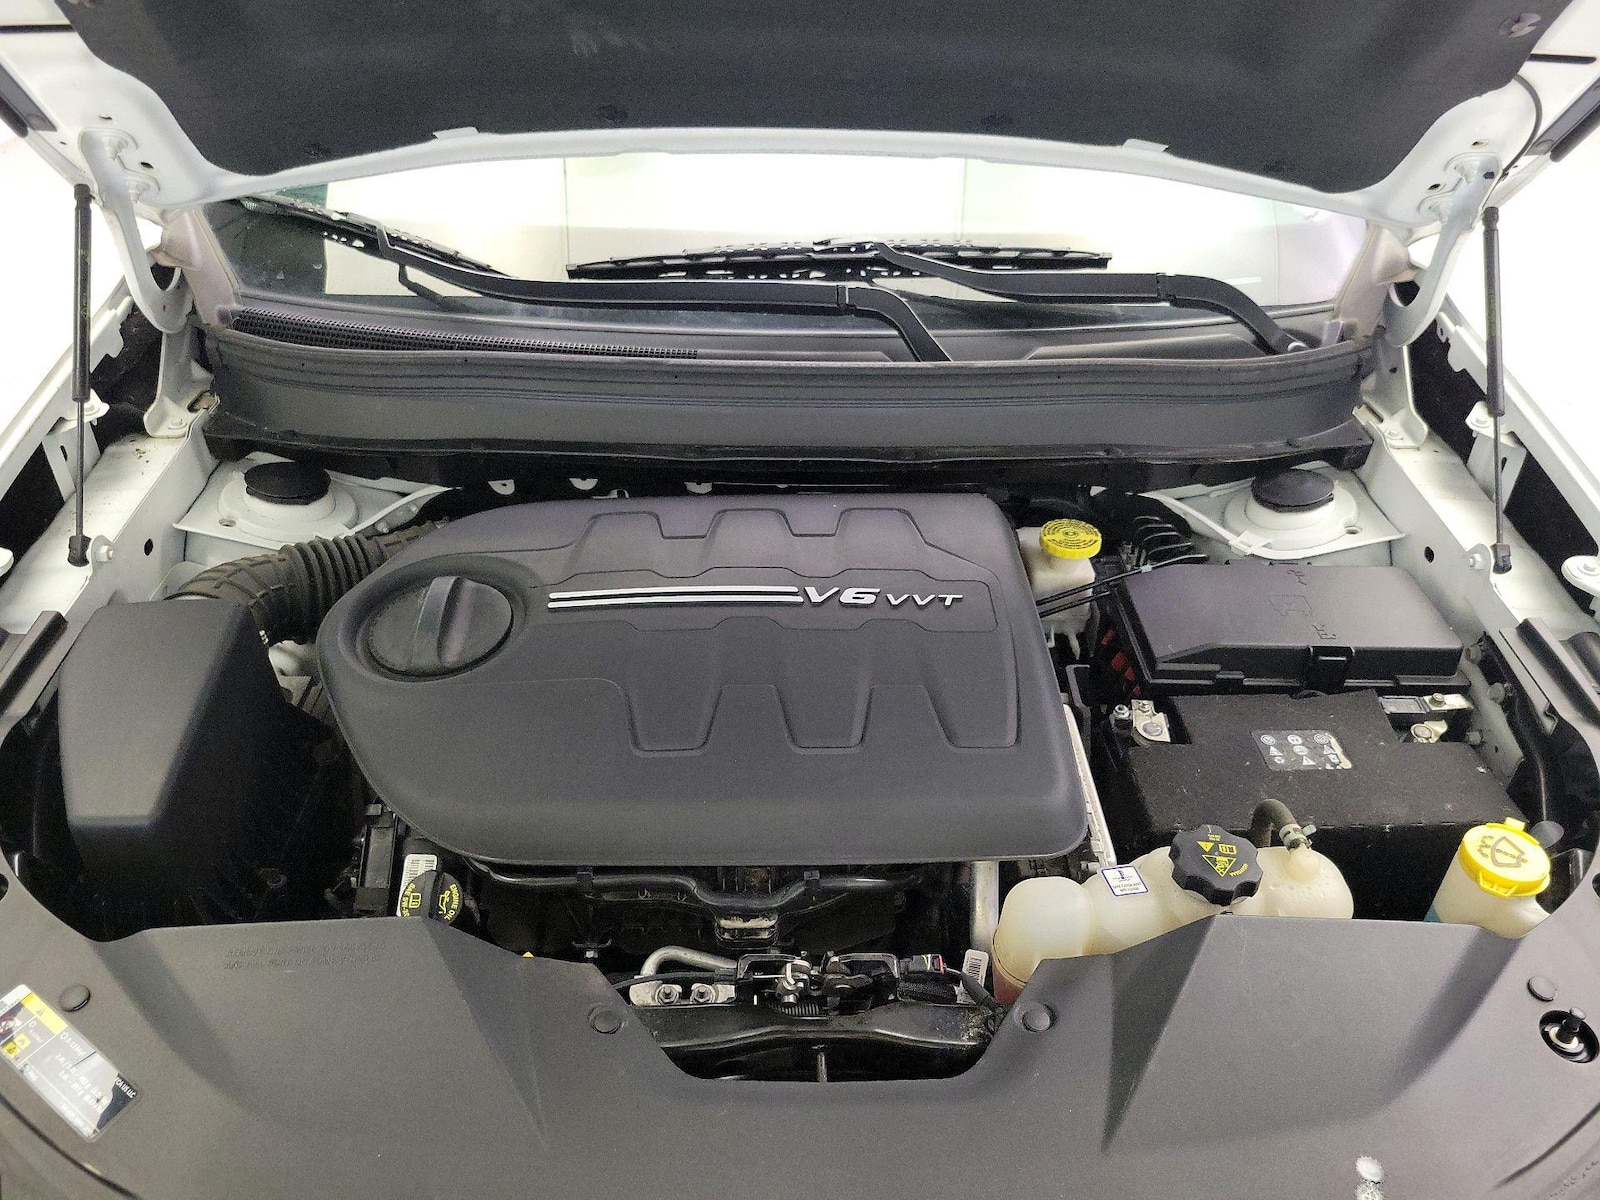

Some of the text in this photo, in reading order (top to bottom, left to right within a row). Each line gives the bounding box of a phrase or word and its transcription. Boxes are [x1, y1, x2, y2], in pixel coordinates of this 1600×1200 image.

[804, 586, 964, 607] V6 VVT
[404, 883, 416, 896] SAE
[443, 884, 460, 921] ENGINE OIL
[127, 1088, 137, 1099] LLC
